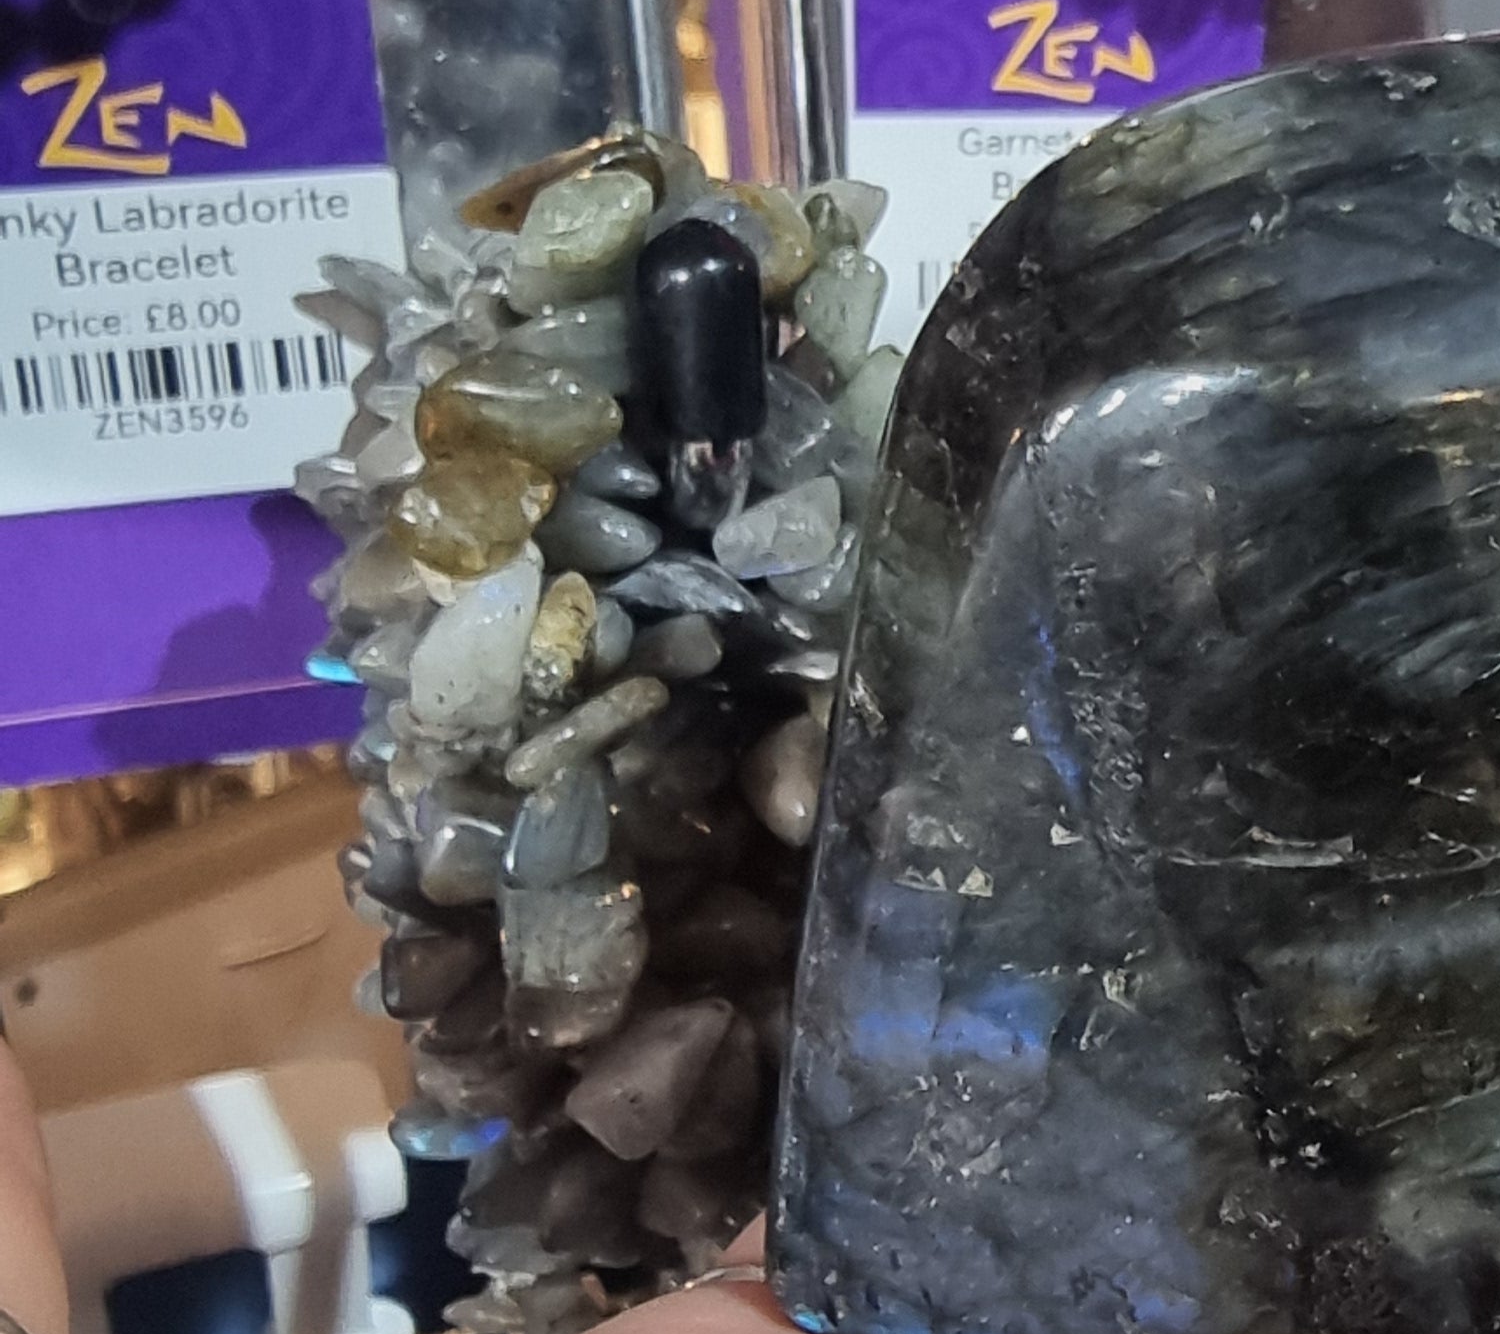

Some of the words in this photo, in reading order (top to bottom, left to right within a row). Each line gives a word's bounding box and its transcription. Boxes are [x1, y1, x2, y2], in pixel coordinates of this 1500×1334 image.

[92, 187, 350, 235] Labradorite
[55, 243, 238, 287] Bracelet
[145, 298, 241, 333] £8.00
[93, 402, 250, 441] ZEN3596
